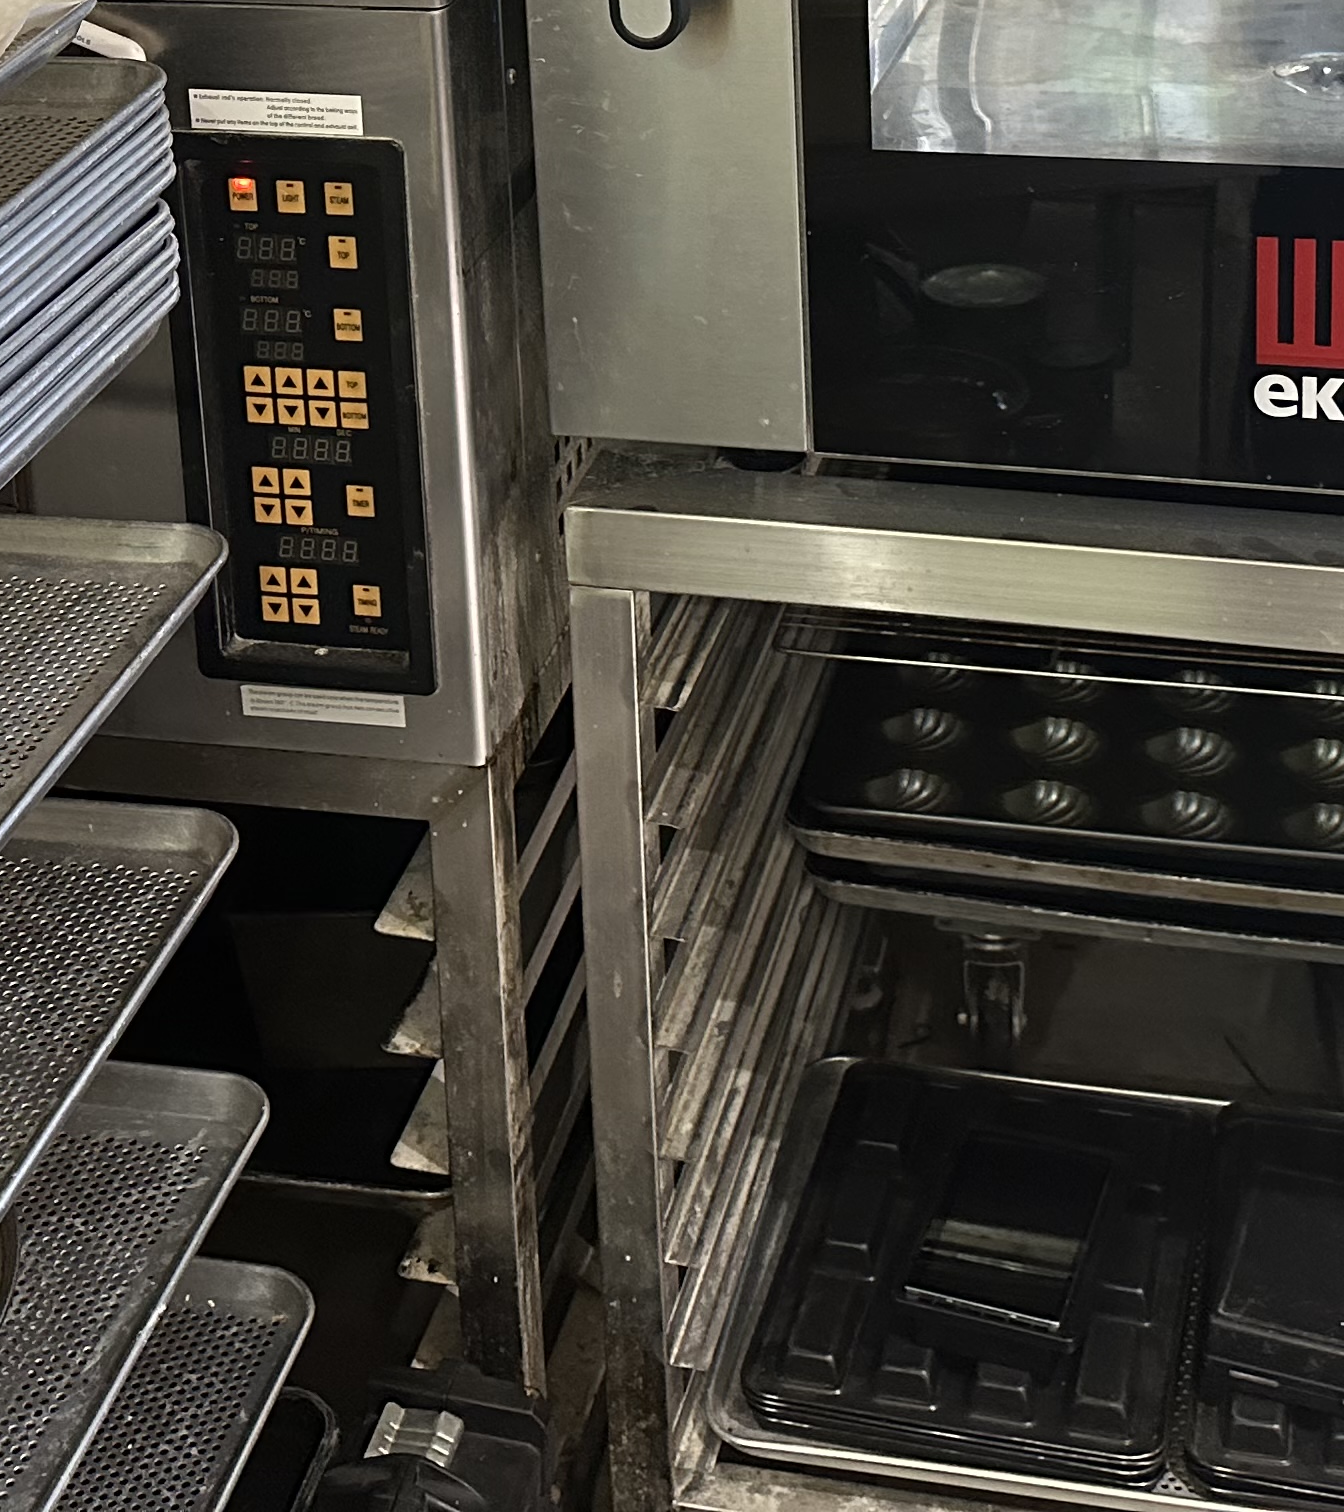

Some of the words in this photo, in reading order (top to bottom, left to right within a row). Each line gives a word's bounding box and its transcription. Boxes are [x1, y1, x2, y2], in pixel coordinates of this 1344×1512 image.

[232, 192, 254, 201] POWER
[282, 194, 300, 202] LIGHT
[329, 196, 350, 205] STEAM
[244, 222, 259, 231] TOP
[337, 251, 350, 260] TOP
[250, 295, 280, 304] BOTTOM
[336, 322, 361, 332] BOTTOM
[345, 380, 358, 389] TOP
[342, 412, 367, 420] BOTTOM
